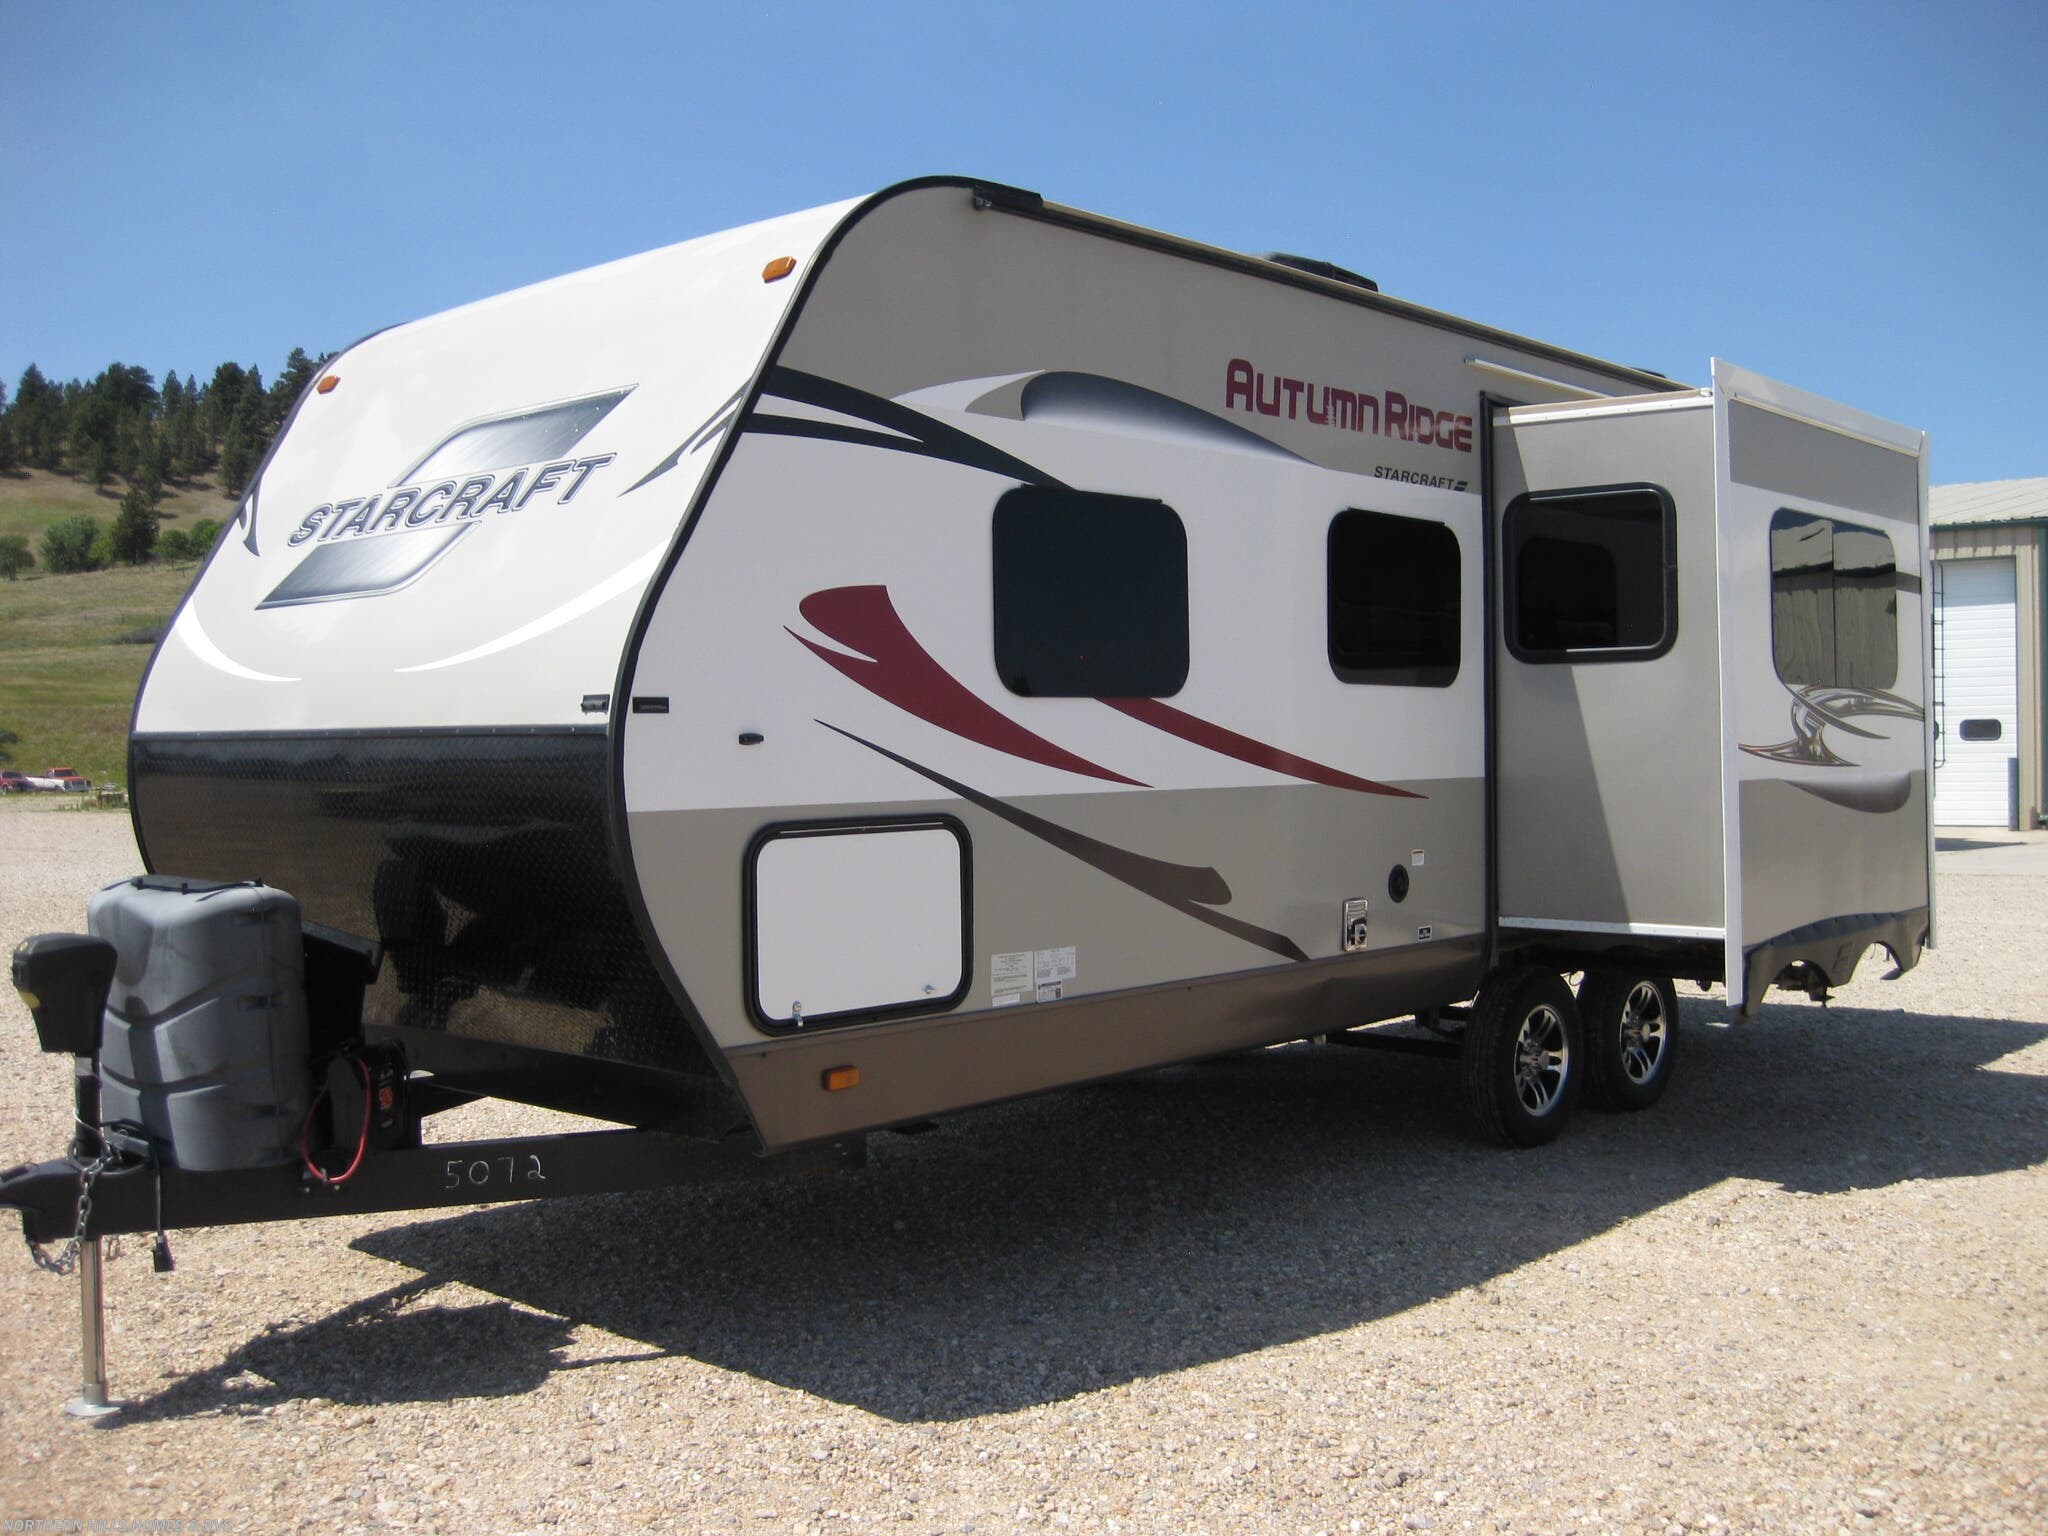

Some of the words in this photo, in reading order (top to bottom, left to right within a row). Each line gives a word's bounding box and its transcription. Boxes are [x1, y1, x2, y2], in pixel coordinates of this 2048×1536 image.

[1225, 357, 1380, 436] AUTUMN
[1383, 389, 1473, 453] RIDGE
[287, 451, 618, 548] STARCRAFT
[1374, 465, 1455, 490] STARCRAFT
[444, 1154, 547, 1189] 5072
